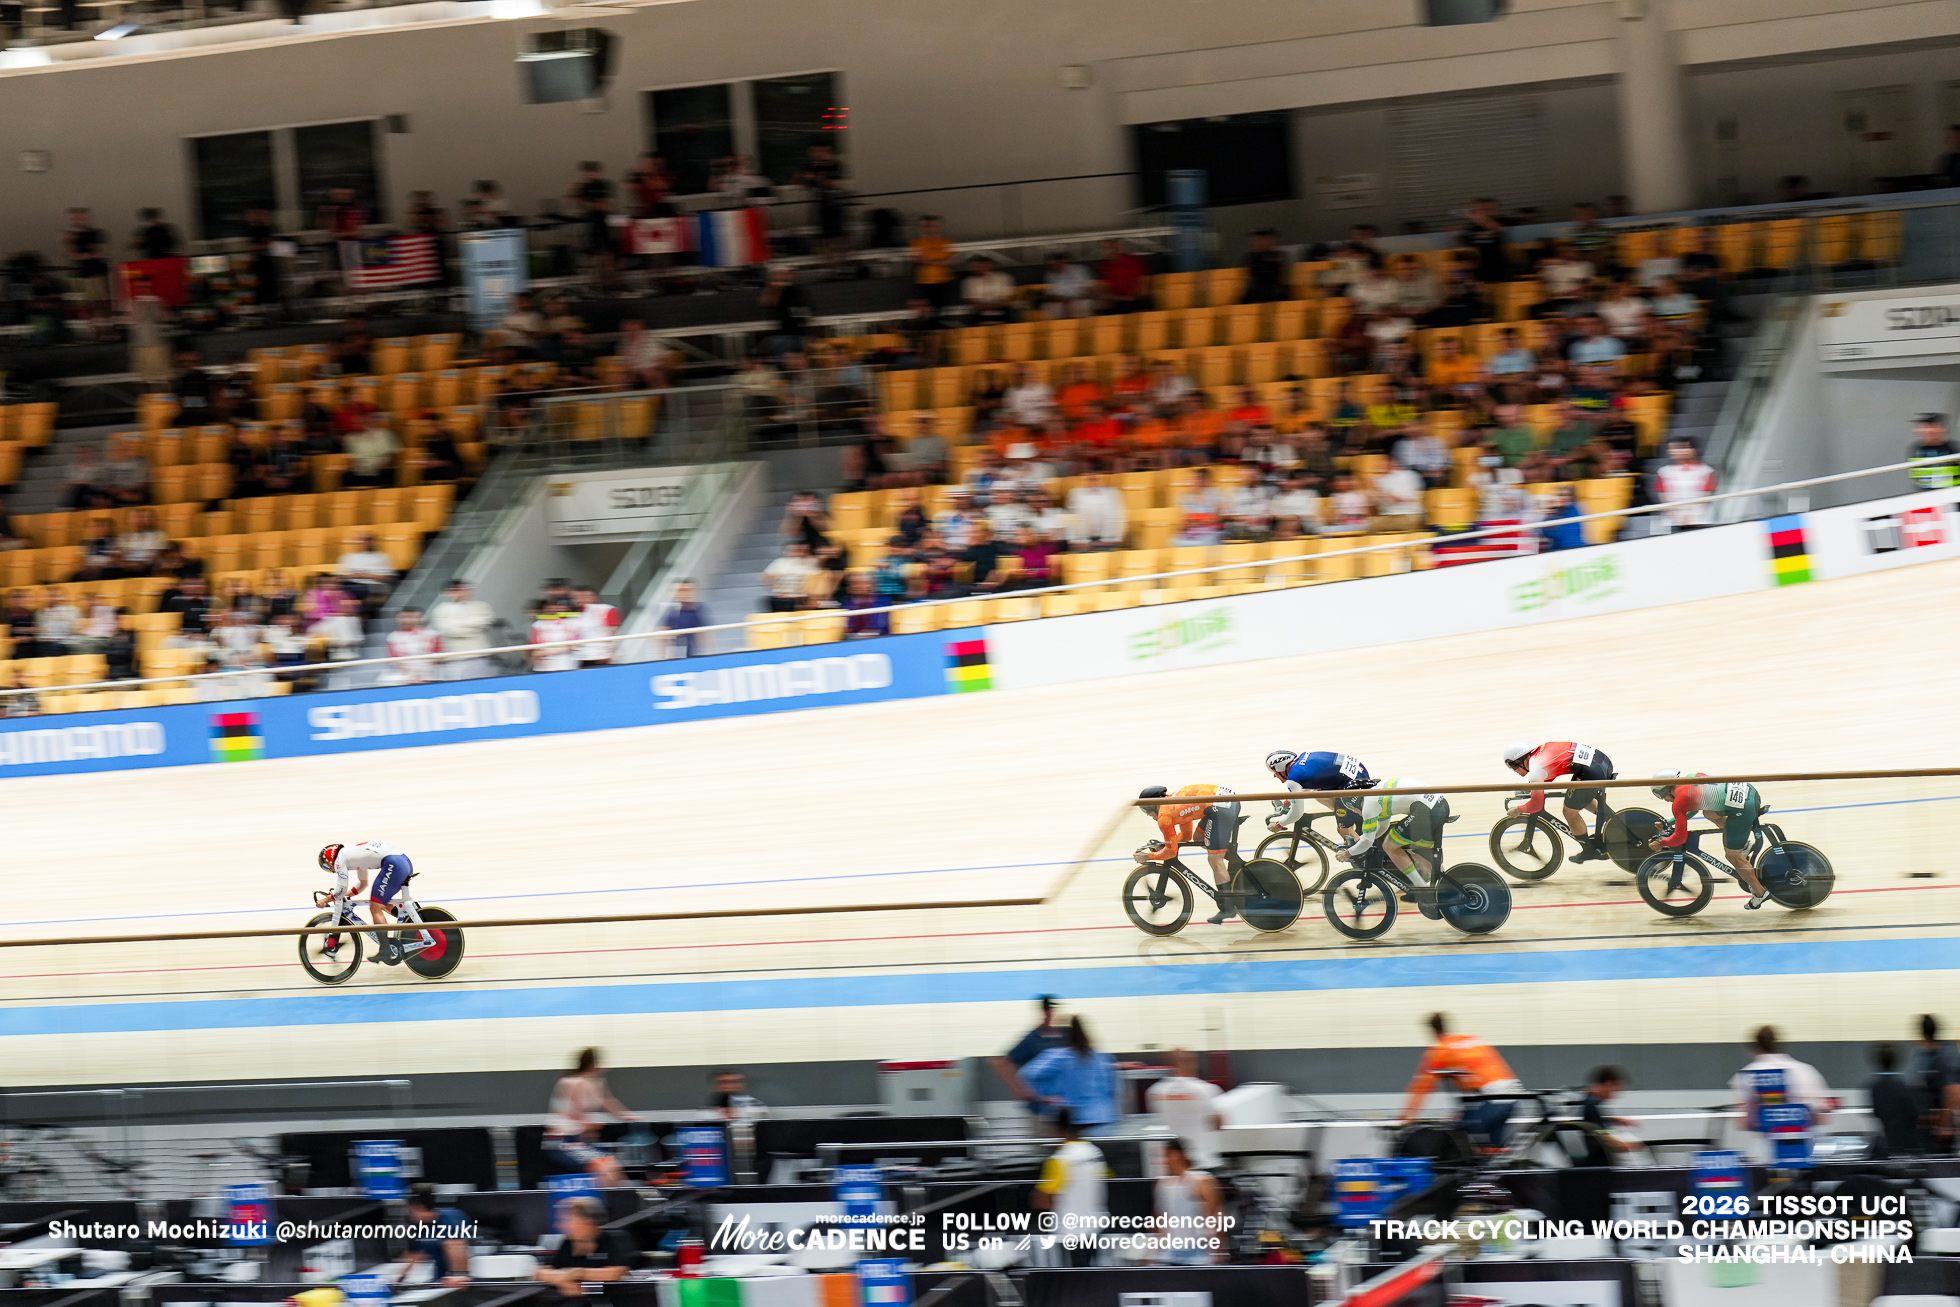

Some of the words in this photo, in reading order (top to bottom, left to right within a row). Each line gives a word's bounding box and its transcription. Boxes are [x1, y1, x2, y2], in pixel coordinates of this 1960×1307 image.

[650, 654, 894, 709] SHIMANO
[307, 690, 541, 740] SHIMANO
[1269, 755, 1292, 766] LAZER
[1730, 790, 1744, 804] 146
[1700, 852, 1734, 876] SPMND
[377, 863, 395, 897] JAPAN
[1183, 869, 1216, 897] KOGA
